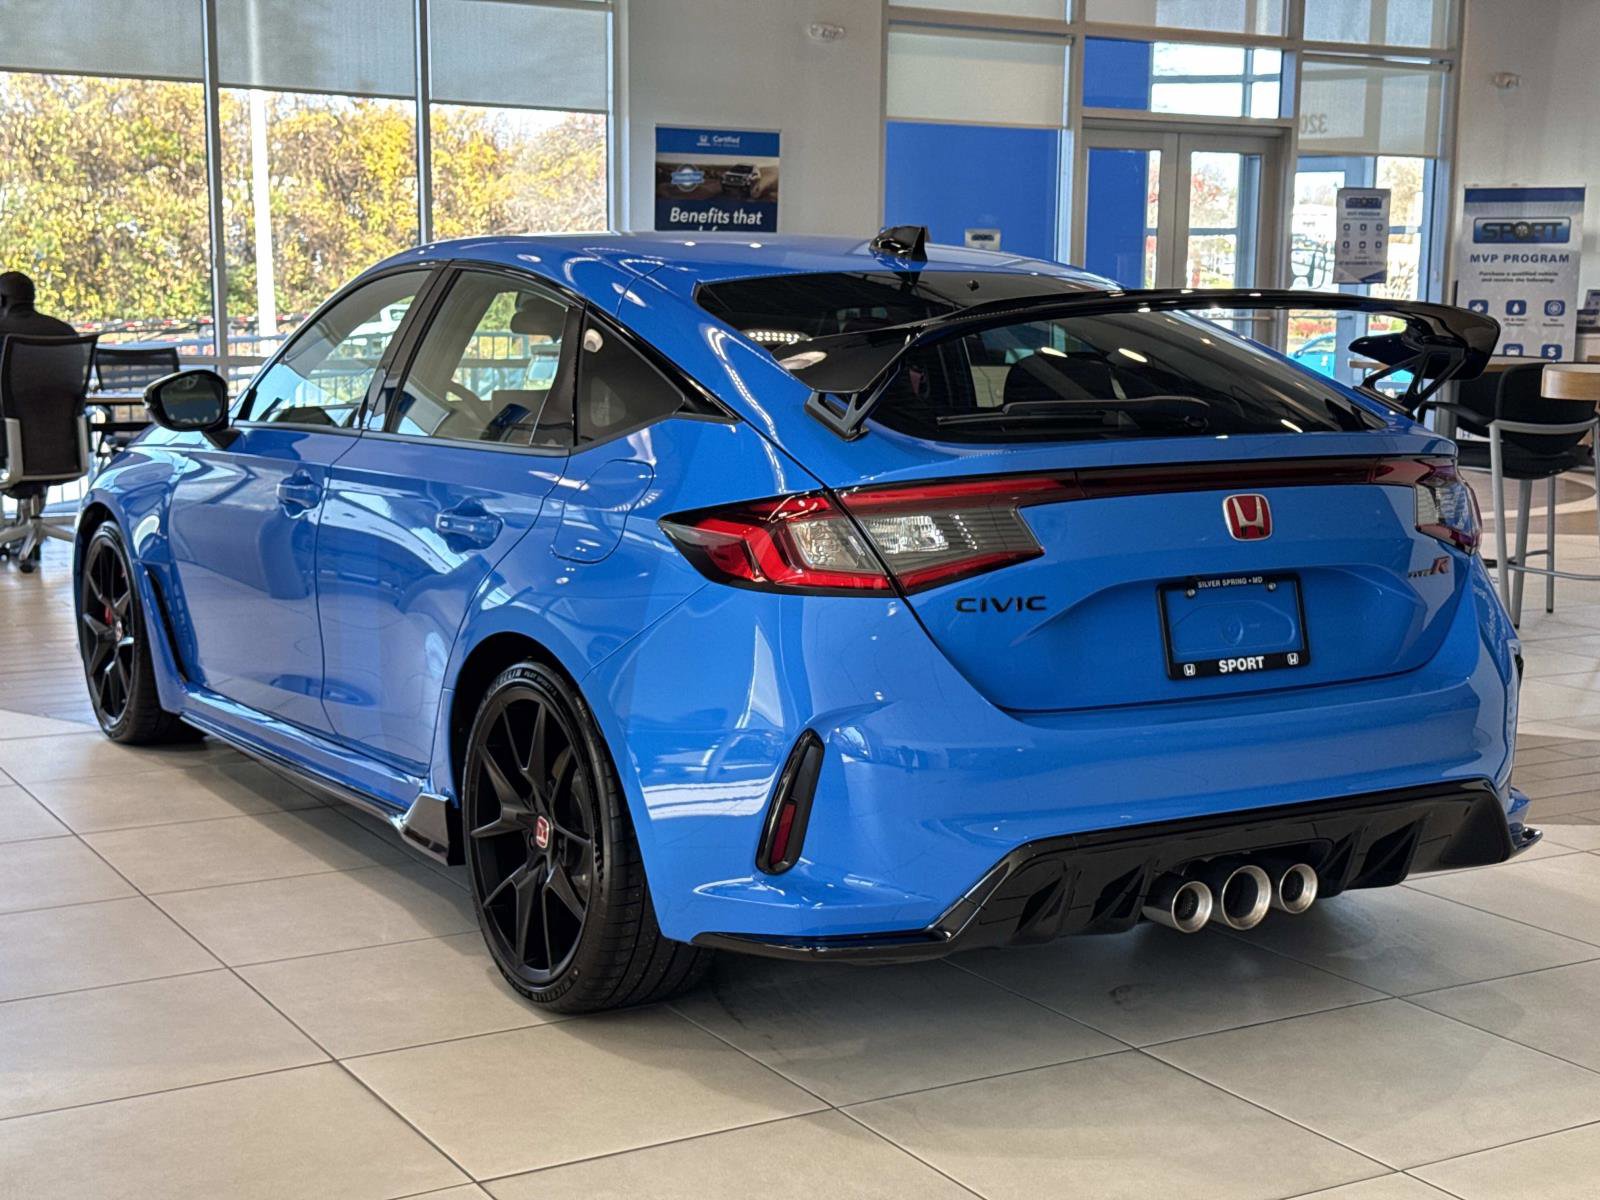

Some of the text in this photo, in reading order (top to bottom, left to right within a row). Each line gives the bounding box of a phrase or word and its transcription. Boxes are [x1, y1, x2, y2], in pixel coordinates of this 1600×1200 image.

[670, 206, 763, 225] Benefits that
[1481, 221, 1563, 240] SPORT
[1470, 254, 1570, 264] MVP PROGRAM
[1197, 576, 1263, 589] SILVER SPRING MD
[955, 595, 1048, 613] CIVIC
[1218, 656, 1265, 674] SPORT
